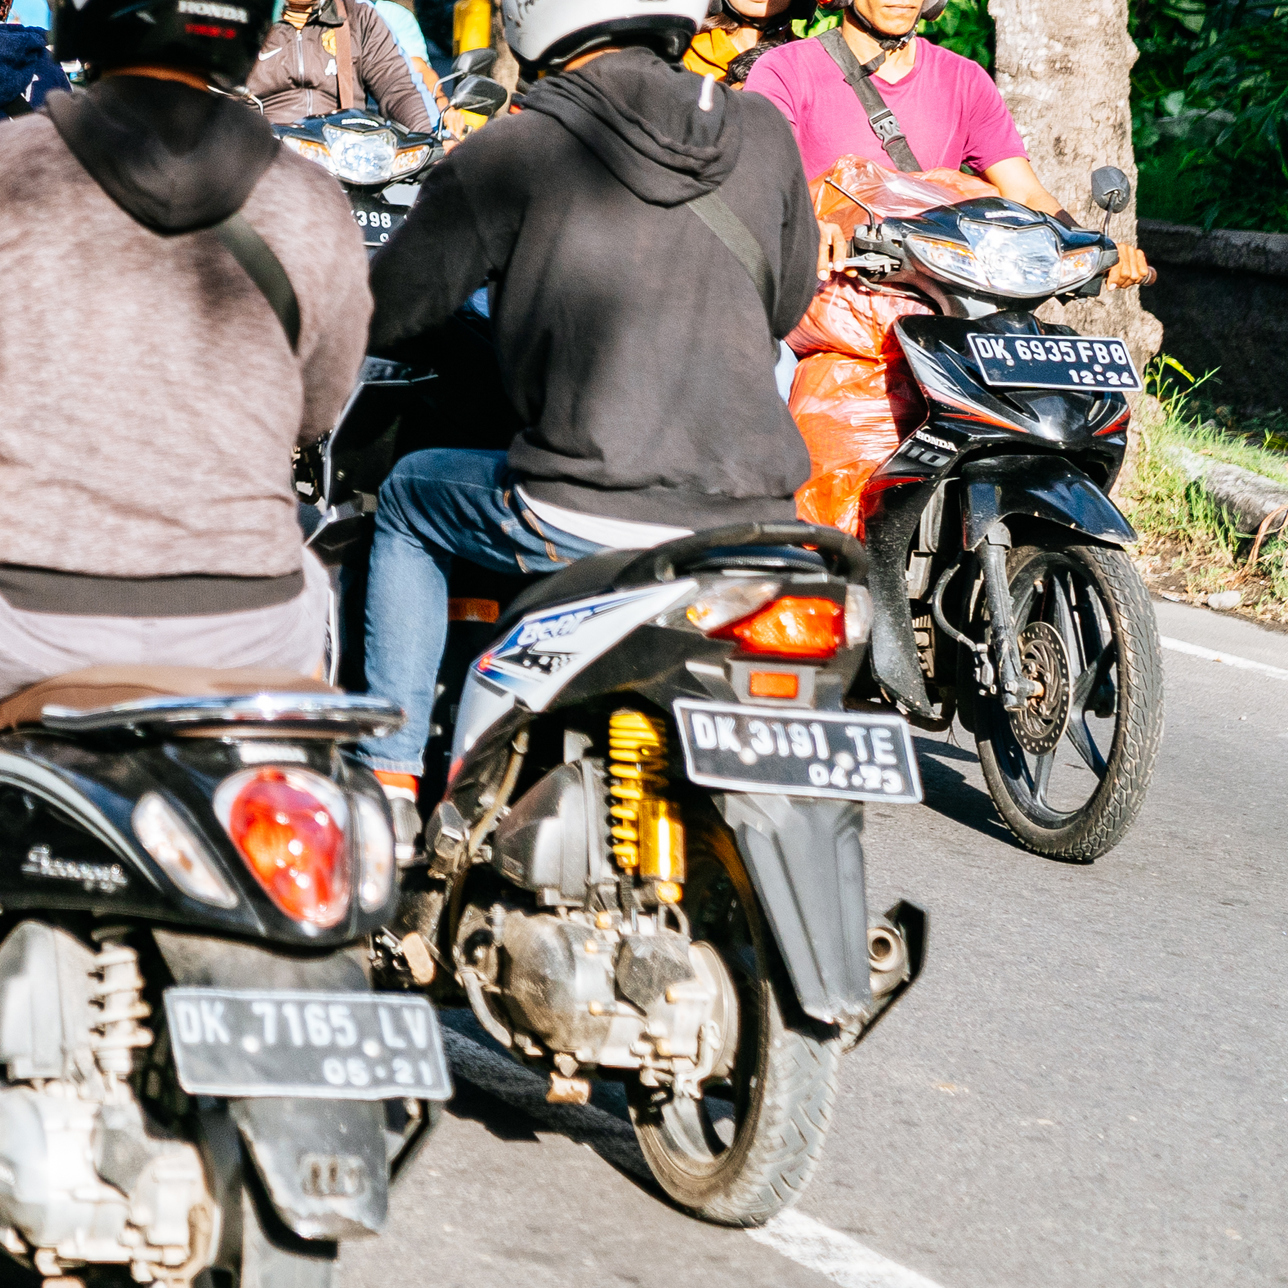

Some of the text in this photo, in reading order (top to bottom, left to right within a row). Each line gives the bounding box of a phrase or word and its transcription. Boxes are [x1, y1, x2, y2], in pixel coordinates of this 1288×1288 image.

[975, 338, 1013, 360] DK
[1015, 340, 1077, 363] 6935
[915, 429, 959, 452] HONDA
[691, 713, 897, 765] DK 3191 TE
[175, 1000, 428, 1049] DK 7165 LV
